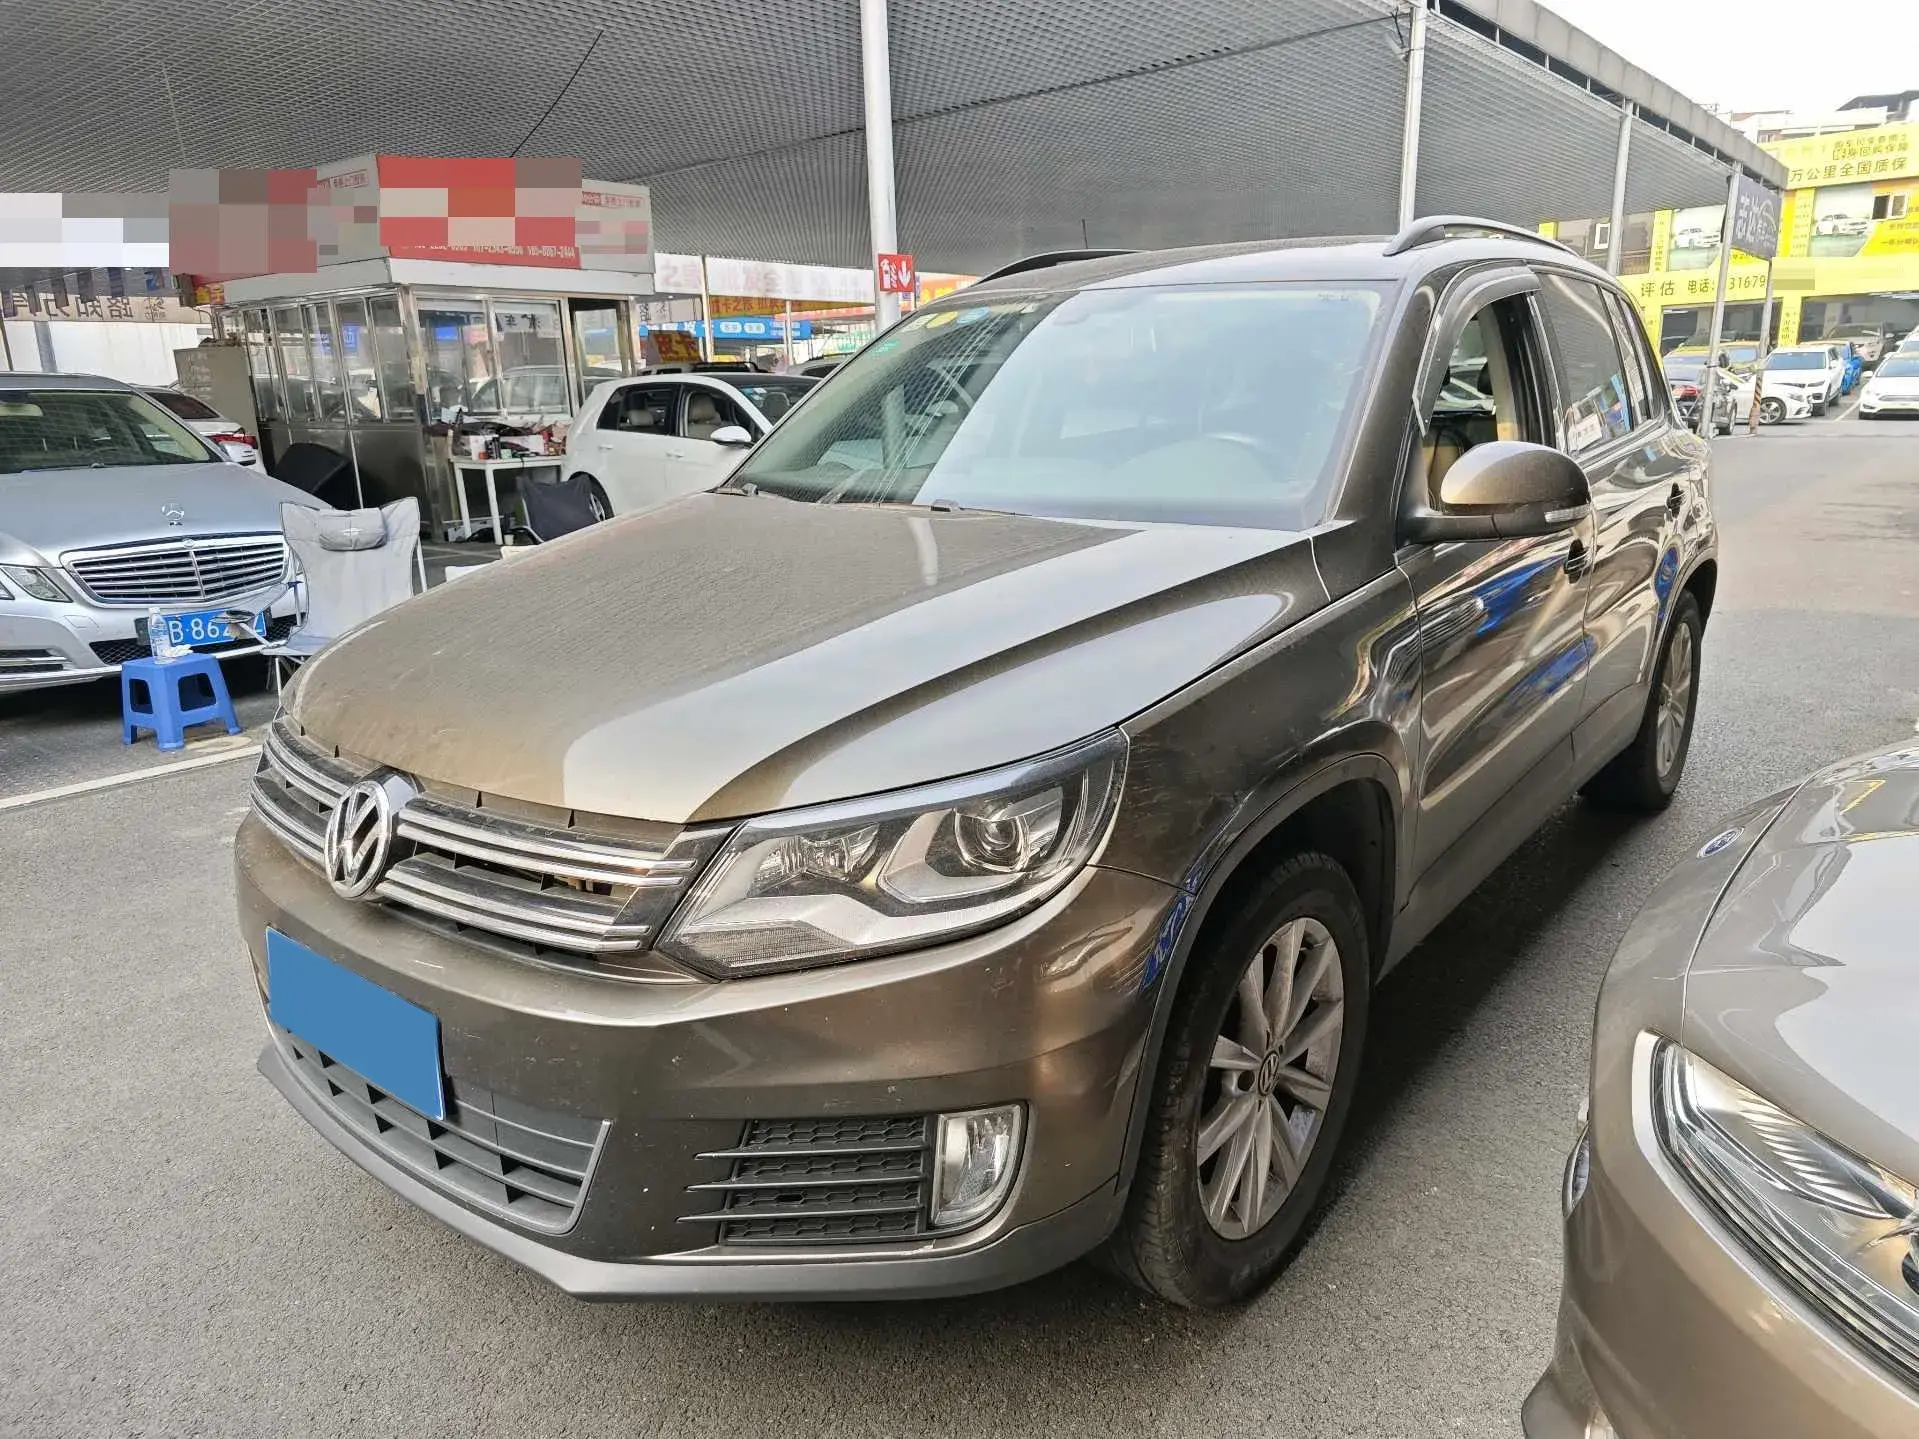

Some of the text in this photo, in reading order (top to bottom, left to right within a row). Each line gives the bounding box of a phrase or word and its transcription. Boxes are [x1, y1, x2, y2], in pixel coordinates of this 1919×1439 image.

[1789, 157, 1908, 182] 万公里全国质保
[1640, 279, 1676, 297] 评估
